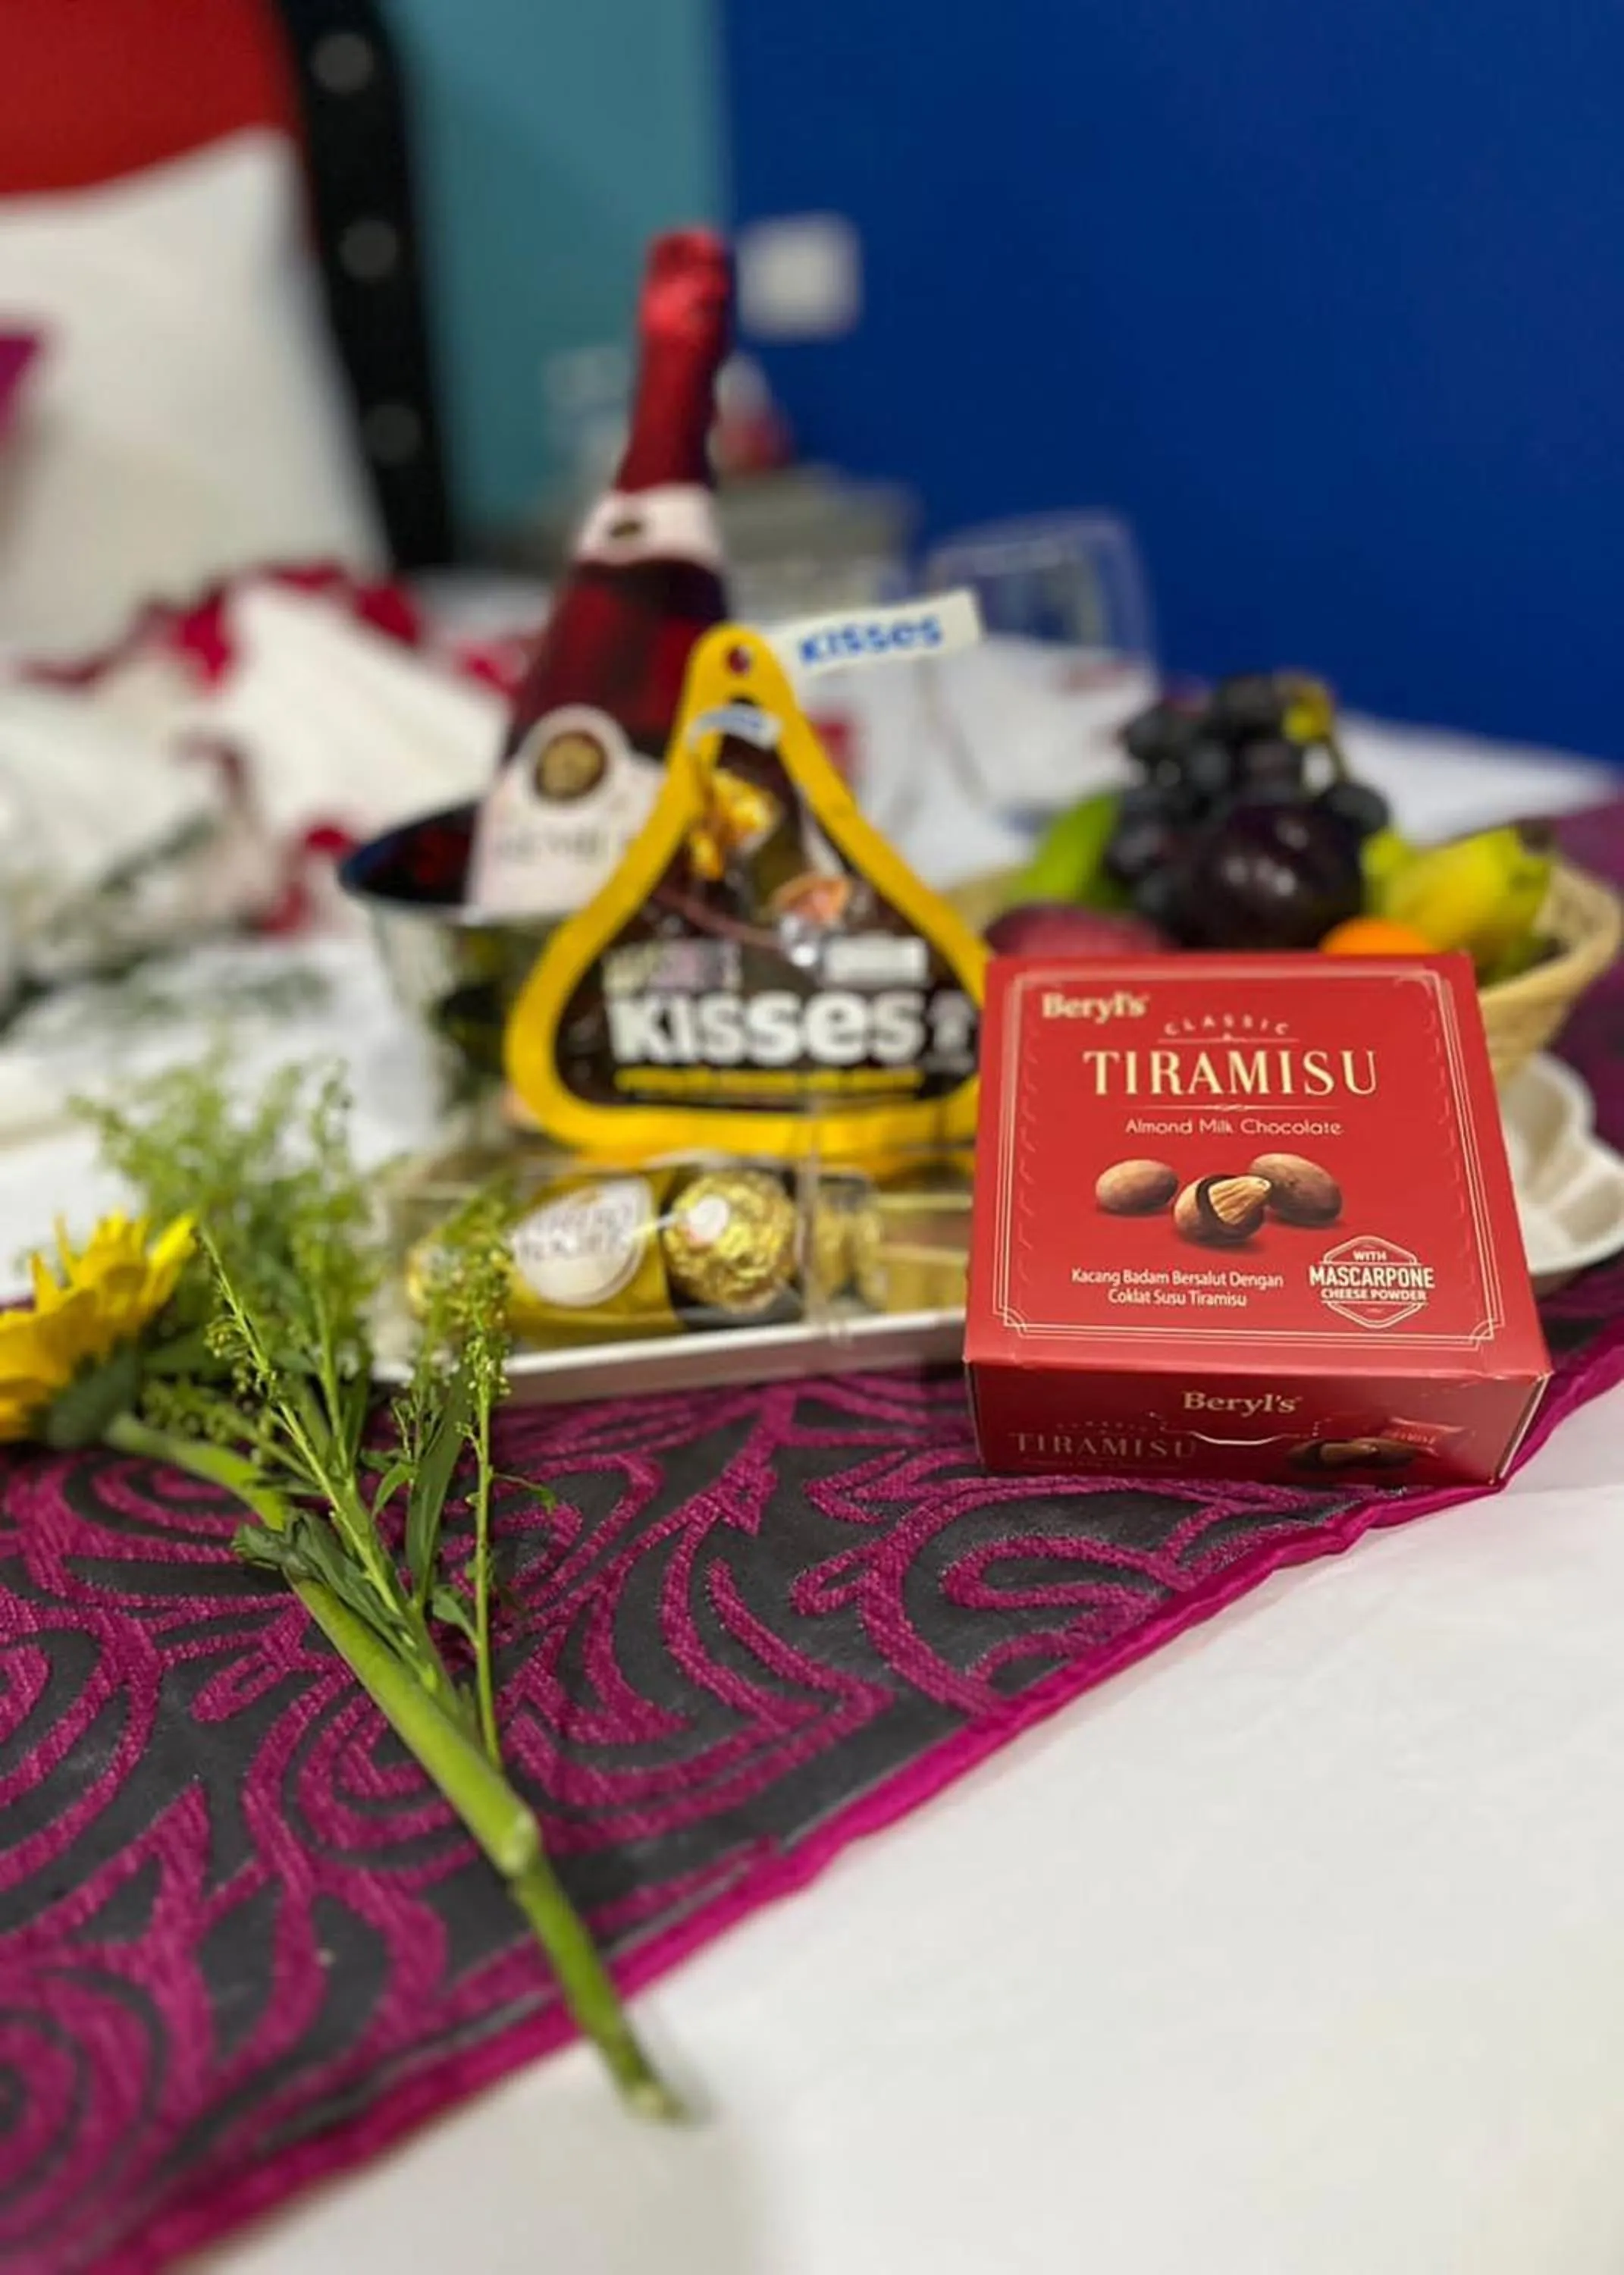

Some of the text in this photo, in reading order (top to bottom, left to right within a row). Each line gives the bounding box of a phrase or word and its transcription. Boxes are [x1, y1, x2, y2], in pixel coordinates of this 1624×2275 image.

[1042, 993, 1146, 1024] Beryl's
[1165, 1014, 1287, 1036] CLASSIC
[1082, 1050, 1378, 1096] TIRAMISU
[1125, 1119, 1343, 1136] Almond Milk Chocolate
[1353, 1251, 1387, 1261] WITH
[1071, 1268, 1284, 1290] Kacang Badam Bersalut Dengan
[1309, 1266, 1435, 1288] MASCARPONE
[1108, 1288, 1247, 1307] Coklat Susu Tiramisu
[1321, 1288, 1426, 1301] CHEESE POWDER
[1183, 1392, 1297, 1417] Beryl's
[1008, 1432, 1196, 1458] TIRAMISU
